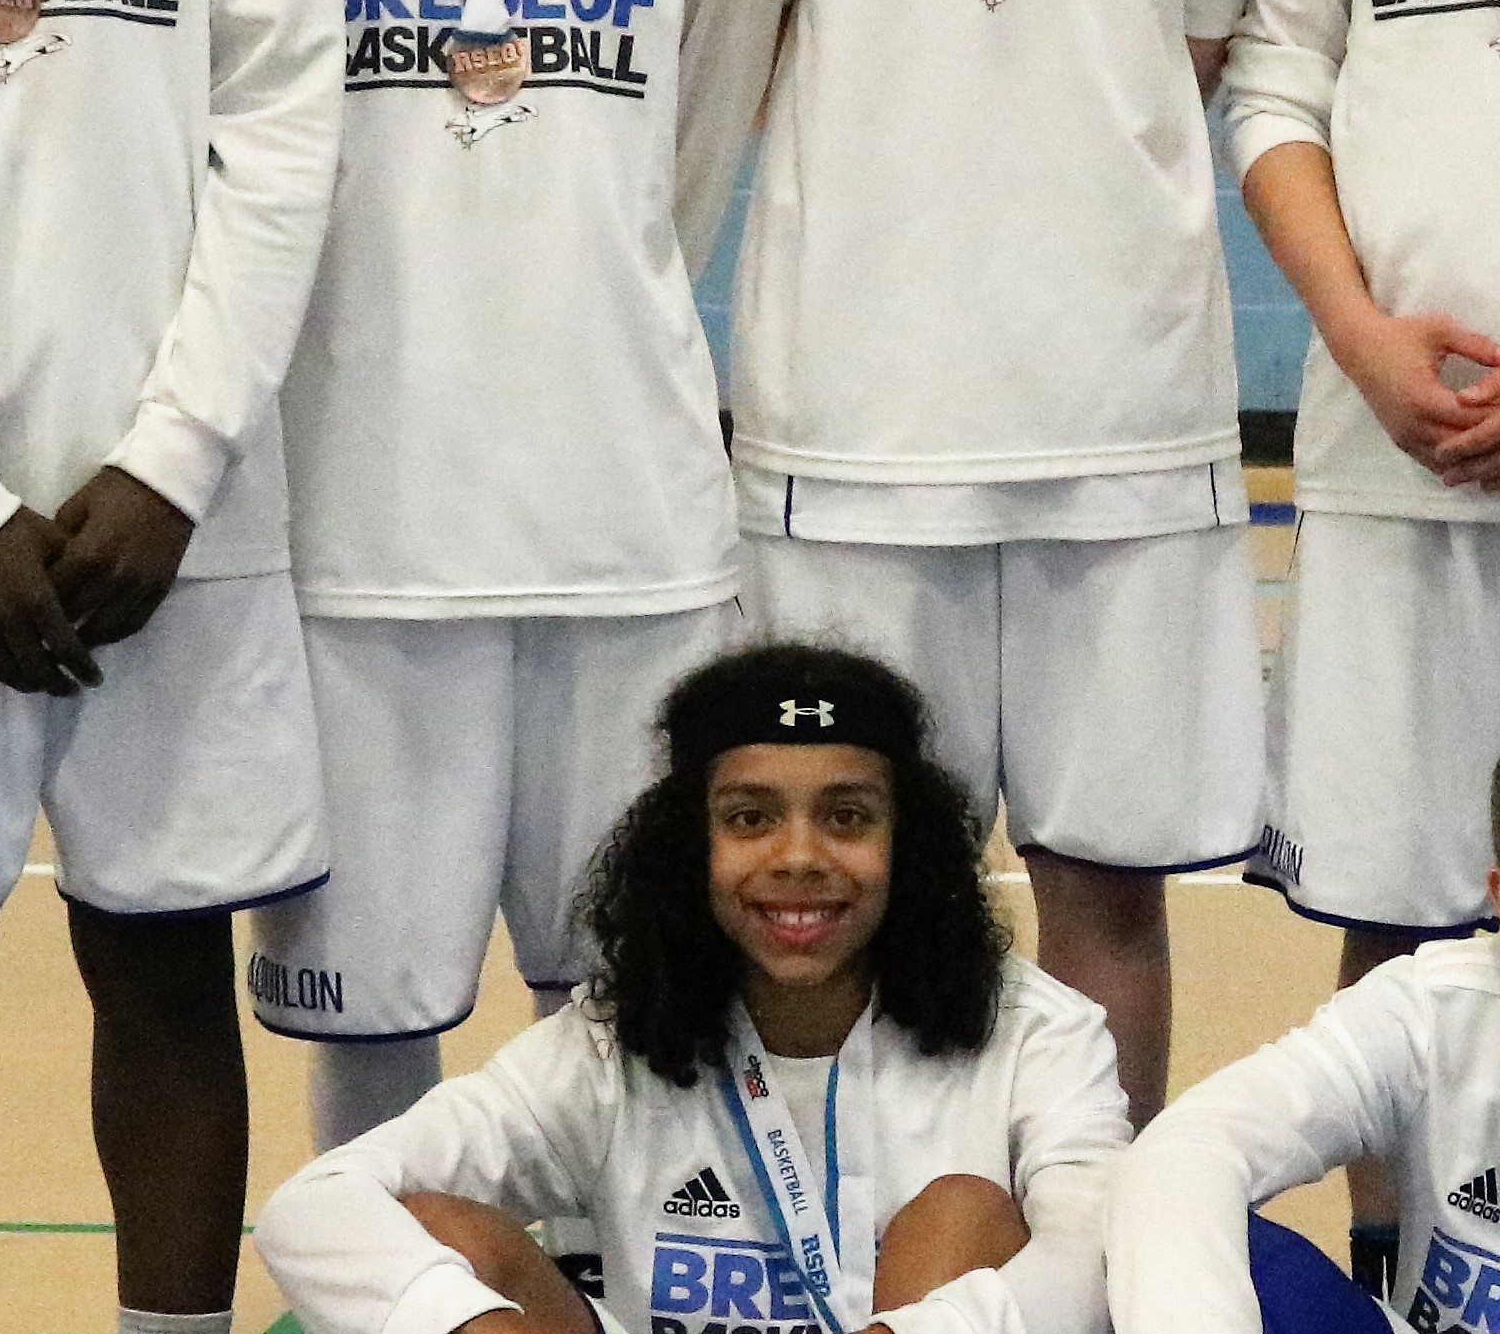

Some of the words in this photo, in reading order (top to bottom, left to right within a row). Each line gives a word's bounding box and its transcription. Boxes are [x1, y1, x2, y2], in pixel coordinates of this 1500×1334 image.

[767, 1129, 808, 1215] BASKETBALL
[663, 1199, 740, 1219] adidas
[1447, 1190, 1500, 1224] adidas
